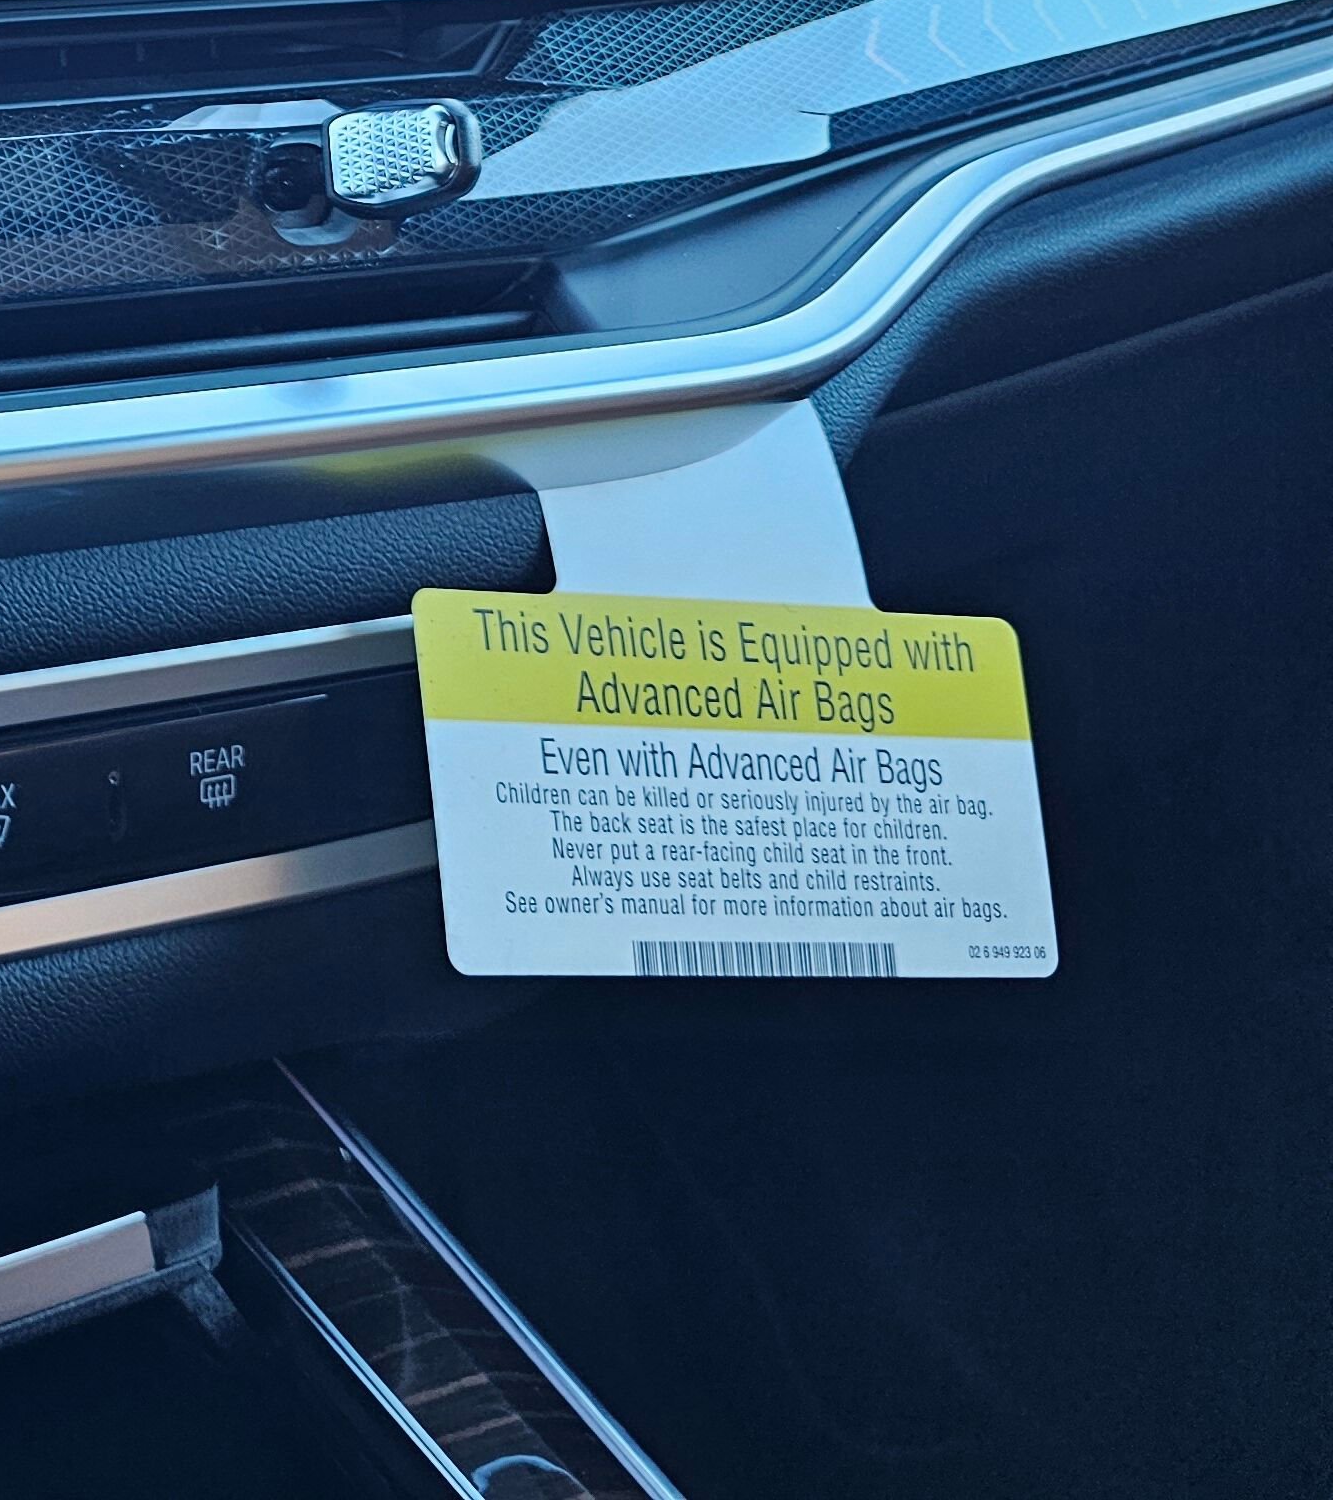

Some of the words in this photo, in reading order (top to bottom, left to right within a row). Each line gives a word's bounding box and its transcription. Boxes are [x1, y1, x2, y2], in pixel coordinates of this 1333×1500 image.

[471, 607, 551, 654] This
[557, 611, 687, 661] Vehicle
[697, 619, 727, 662] is
[737, 621, 893, 677] Equipped
[902, 630, 975, 672] with
[576, 670, 743, 719] Advanced
[756, 677, 801, 721] Air
[813, 680, 895, 733] Bags
[189, 744, 246, 777] REAR
[539, 737, 610, 777] Even
[615, 740, 678, 778] with
[688, 742, 821, 783] Advanced
[831, 747, 868, 784] Air
[875, 748, 943, 793] Bags
[495, 781, 571, 806] Children
[578, 788, 610, 807] can
[614, 785, 636, 808] be
[641, 786, 690, 809] killed
[696, 790, 714, 809] or
[720, 789, 799, 816] seriously
[804, 790, 864, 817] injured
[870, 792, 890, 817] by
[896, 793, 922, 814] the
[929, 795, 950, 815] air
[955, 795, 994, 820] bag.
[549, 809, 583, 833] The
[589, 811, 633, 834] back
[637, 813, 673, 835] seat
[679, 813, 695, 836] is
[701, 815, 728, 836] the
[734, 815, 787, 837] safest
[793, 817, 837, 841] place
[842, 818, 867, 839] for
[873, 819, 948, 841] children.
[551, 836, 603, 860] Never
[610, 841, 640, 864] put
[645, 844, 656, 862] a
[661, 841, 757, 867] rear-facing
[763, 842, 804, 864] child
[811, 843, 847, 865] seat
[852, 843, 869, 866] in
[874, 844, 900, 866] the
[905, 844, 953, 867] front.
[571, 864, 634, 891] Always
[640, 870, 671, 889] use
[677, 868, 714, 890] seat
[720, 867, 762, 890] belts
[768, 868, 799, 890] and
[805, 869, 848, 891] child
[853, 871, 941, 893] restraints.
[504, 890, 538, 914] See
[544, 892, 615, 915] owner's
[621, 894, 685, 916] manual
[691, 893, 716, 916] for
[723, 896, 767, 917] more
[772, 895, 874, 918] information
[879, 897, 929, 918] about
[933, 897, 955, 919] air
[961, 898, 1008, 922] bags.
[968, 945, 982, 959] 02
[983, 945, 990, 959] 6
[1013, 945, 1032, 959] 923
[1034, 946, 1046, 959] 06
